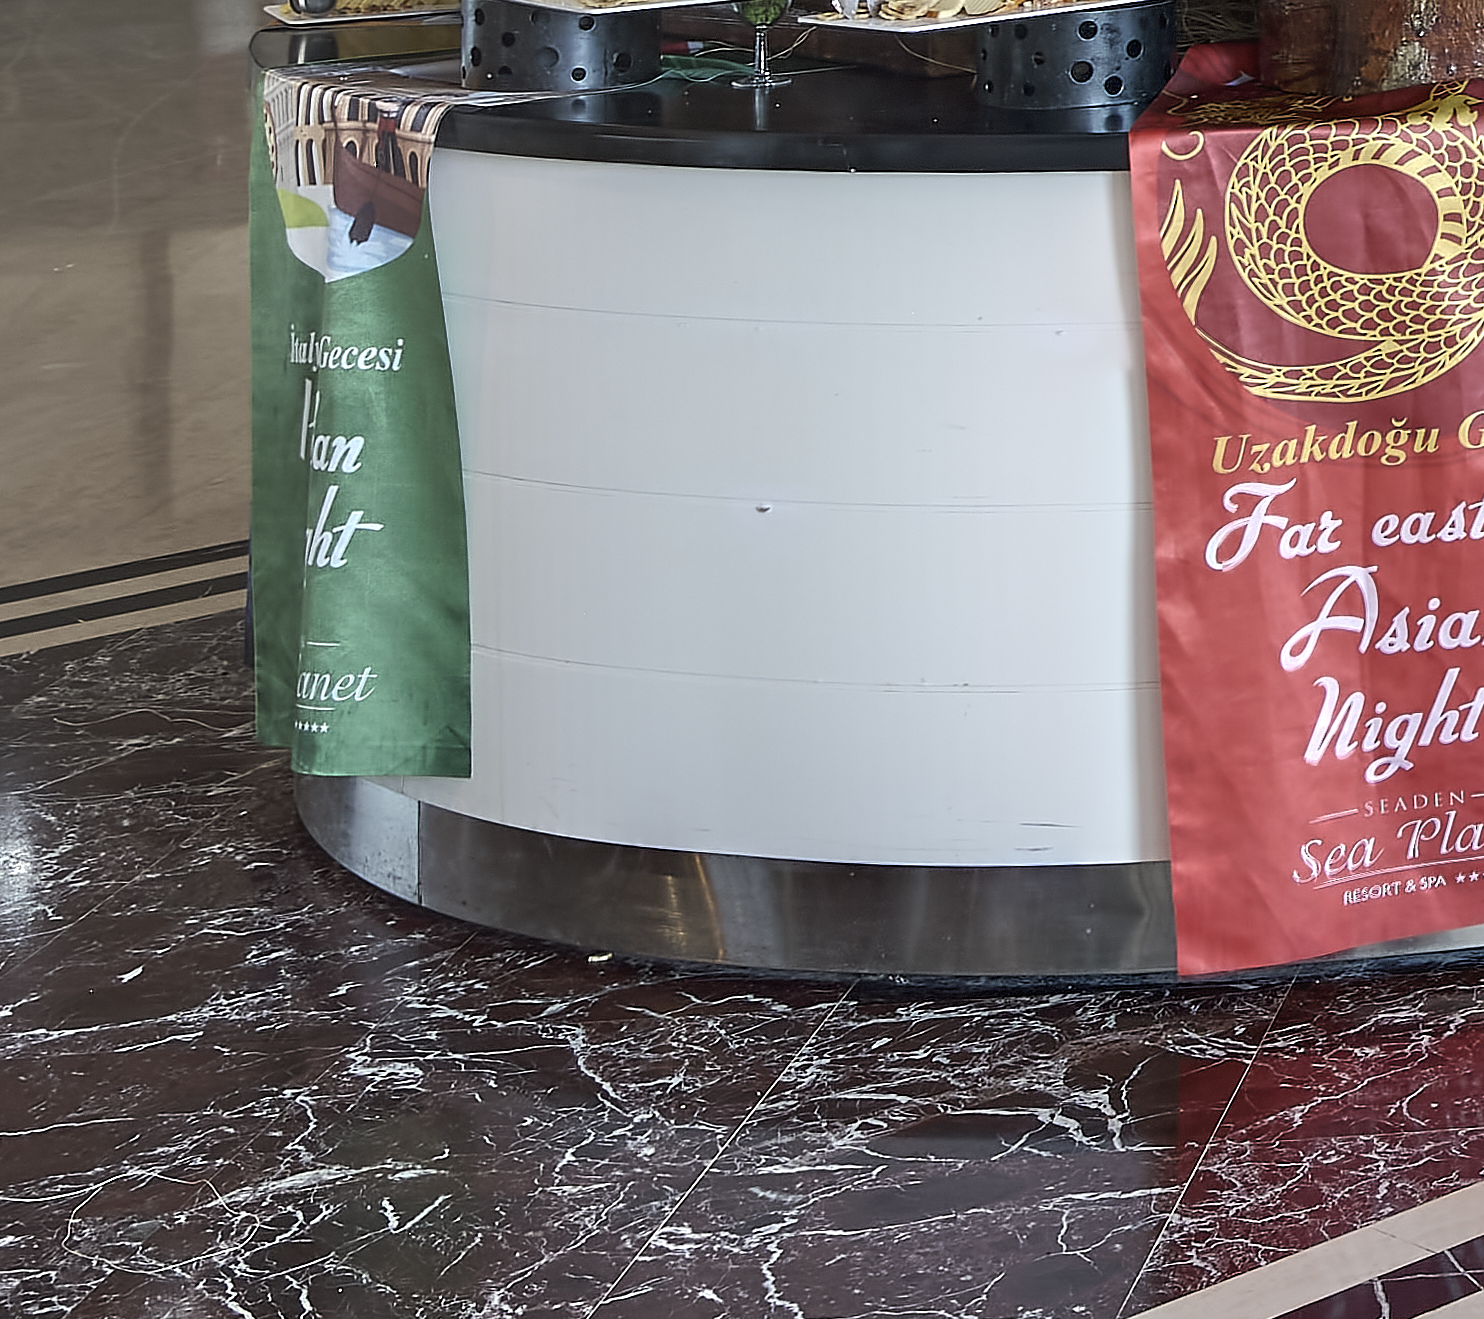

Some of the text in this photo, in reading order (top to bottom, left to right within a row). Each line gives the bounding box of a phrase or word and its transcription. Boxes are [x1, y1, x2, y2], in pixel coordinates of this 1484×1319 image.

[319, 334, 404, 372] Gecesi
[1211, 416, 1439, 474] Uzakdoğu
[1204, 478, 1343, 572] Far
[1363, 790, 1466, 817] SEADEN
[1292, 836, 1385, 884] Sea
[1342, 873, 1447, 906] RESORT & SPA
